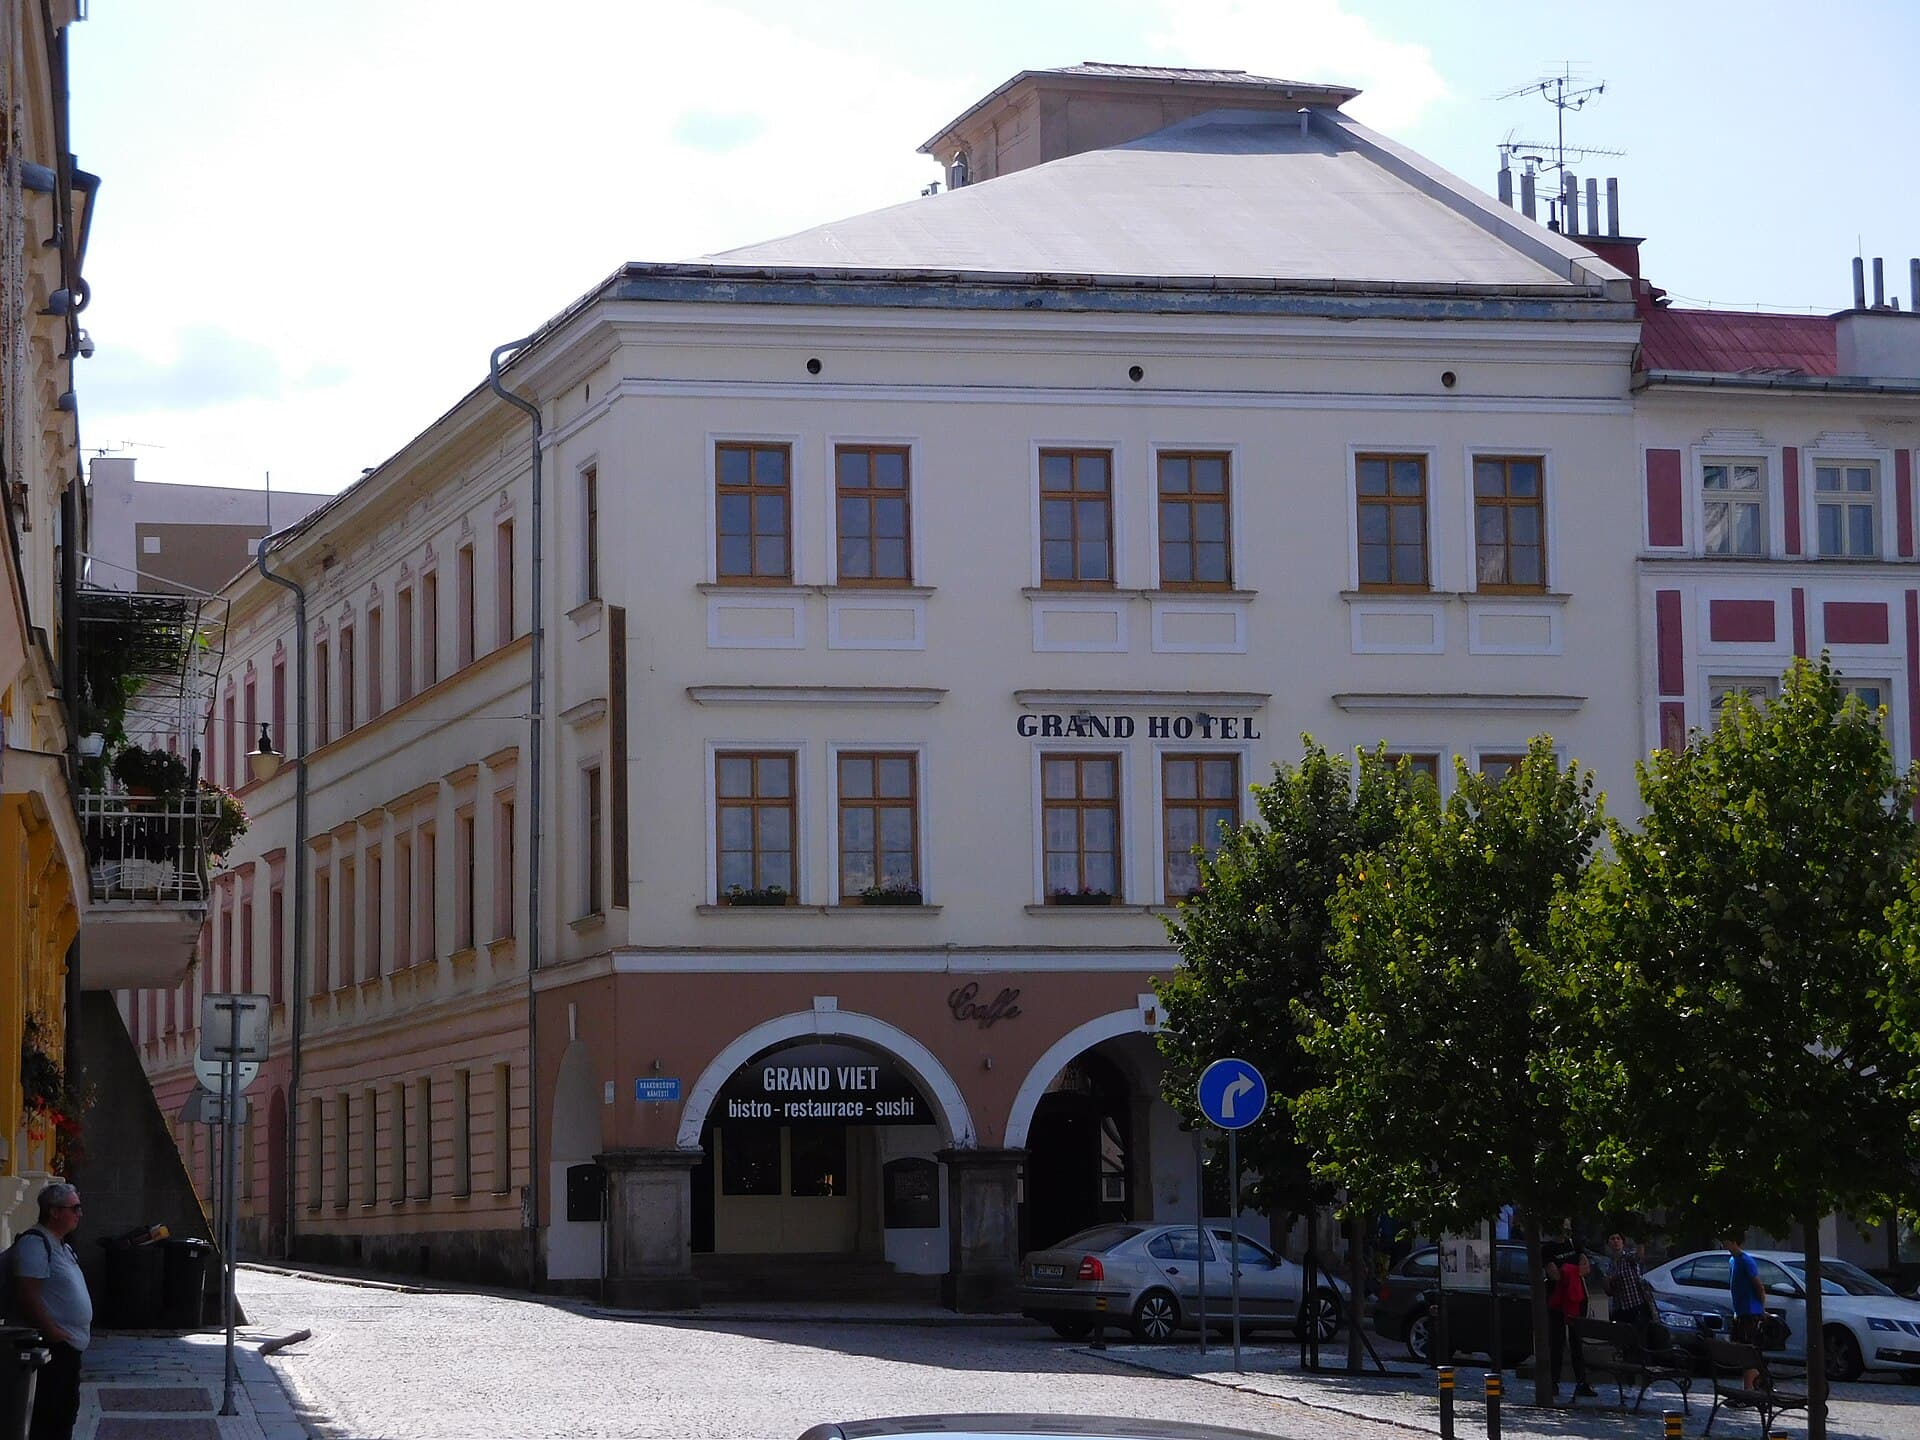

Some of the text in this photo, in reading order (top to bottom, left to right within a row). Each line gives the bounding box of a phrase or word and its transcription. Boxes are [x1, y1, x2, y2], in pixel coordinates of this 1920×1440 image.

[1016, 714, 1261, 740] GRAND HOTEL
[763, 1066, 879, 1092] GRAND VIET
[728, 1098, 772, 1119] bistro
[784, 1100, 864, 1118] restaurace
[875, 1096, 915, 1117] sushi
